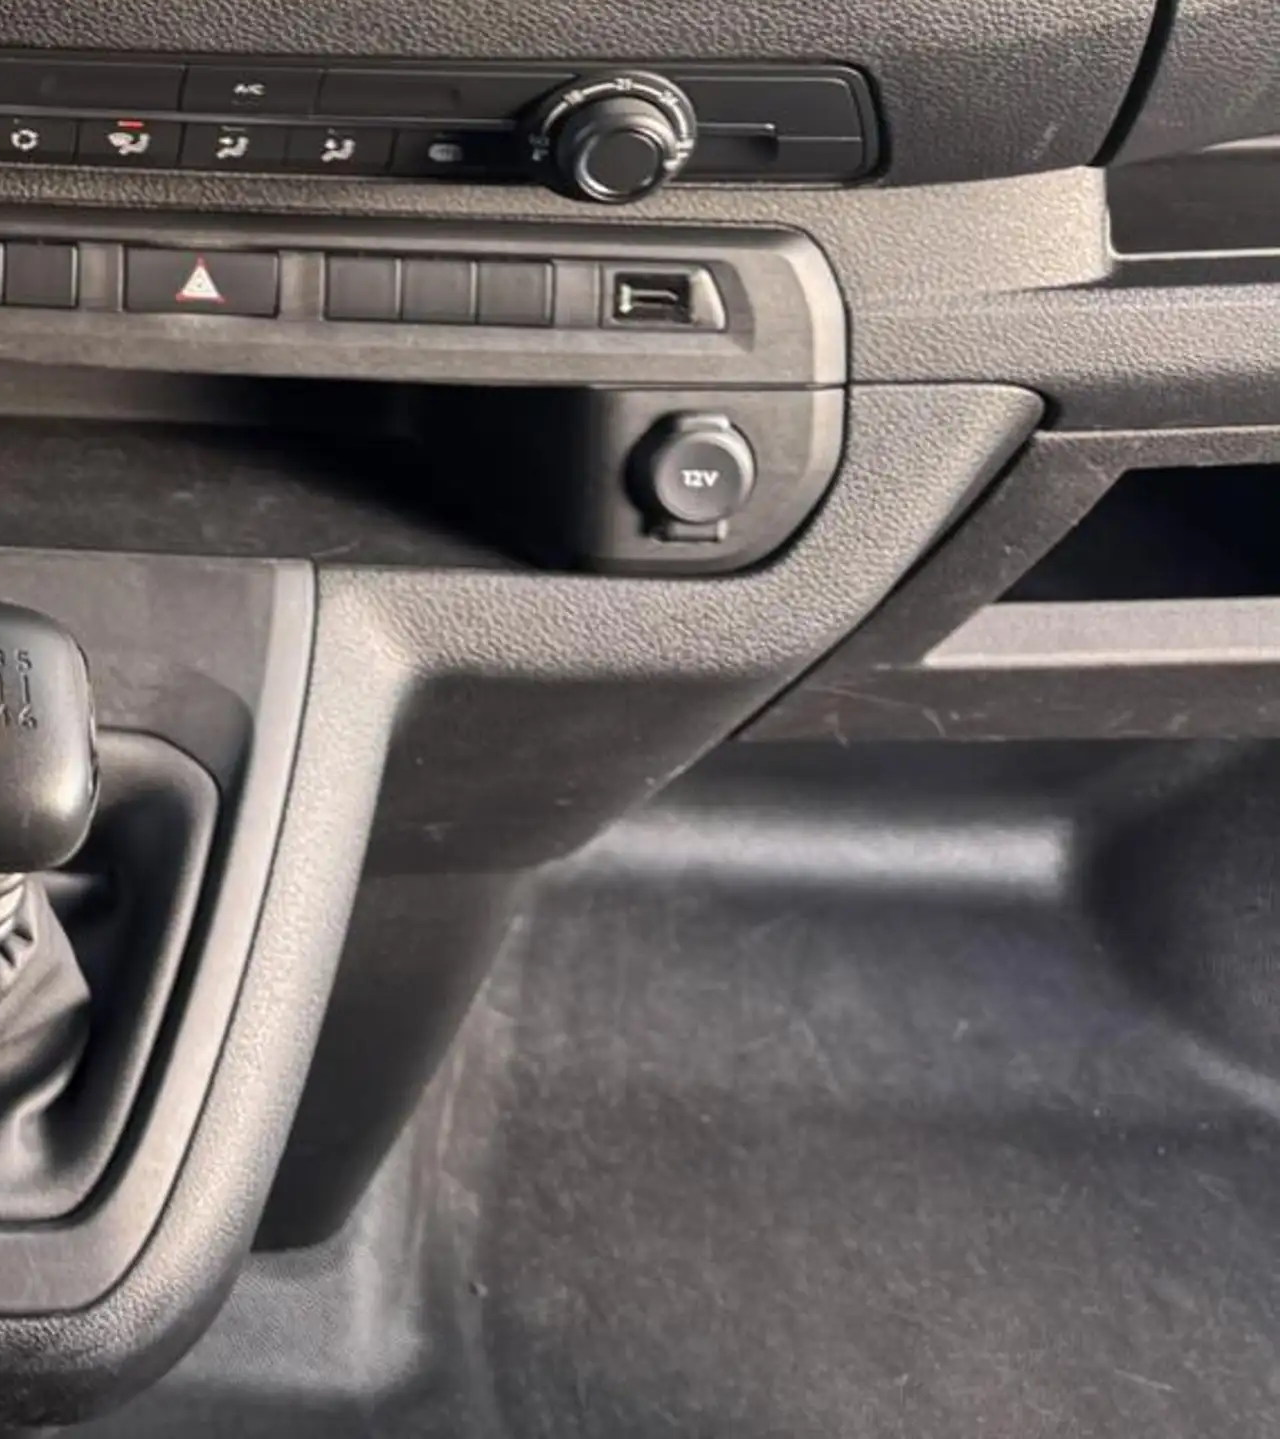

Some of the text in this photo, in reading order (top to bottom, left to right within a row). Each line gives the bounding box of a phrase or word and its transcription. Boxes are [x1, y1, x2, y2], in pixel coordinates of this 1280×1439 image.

[681, 471, 719, 488] 12V
[14, 647, 33, 673] 5
[17, 704, 37, 729] 6
